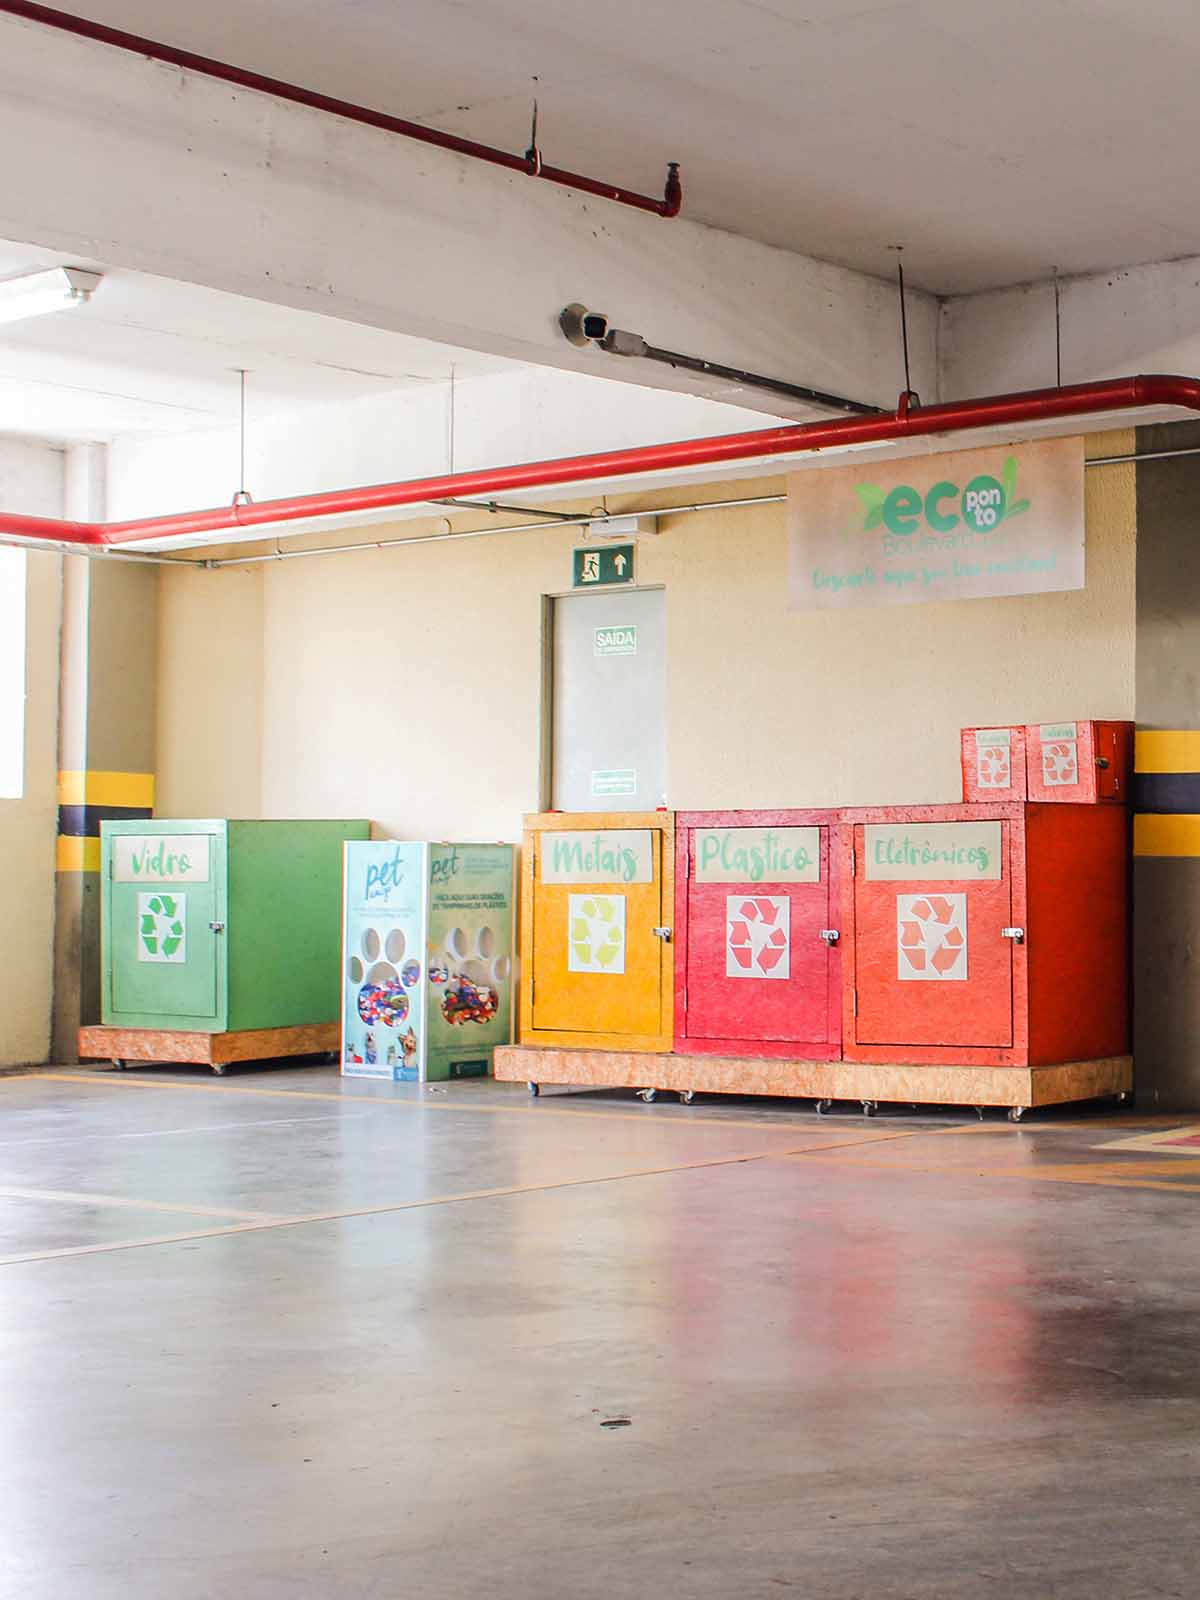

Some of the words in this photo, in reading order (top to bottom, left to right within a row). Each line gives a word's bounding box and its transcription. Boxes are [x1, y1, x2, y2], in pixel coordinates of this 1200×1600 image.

[882, 475, 1007, 537] eco
[132, 840, 192, 877] Vidro
[366, 846, 404, 900] pet
[430, 847, 461, 884] pet
[552, 832, 639, 881] Metais
